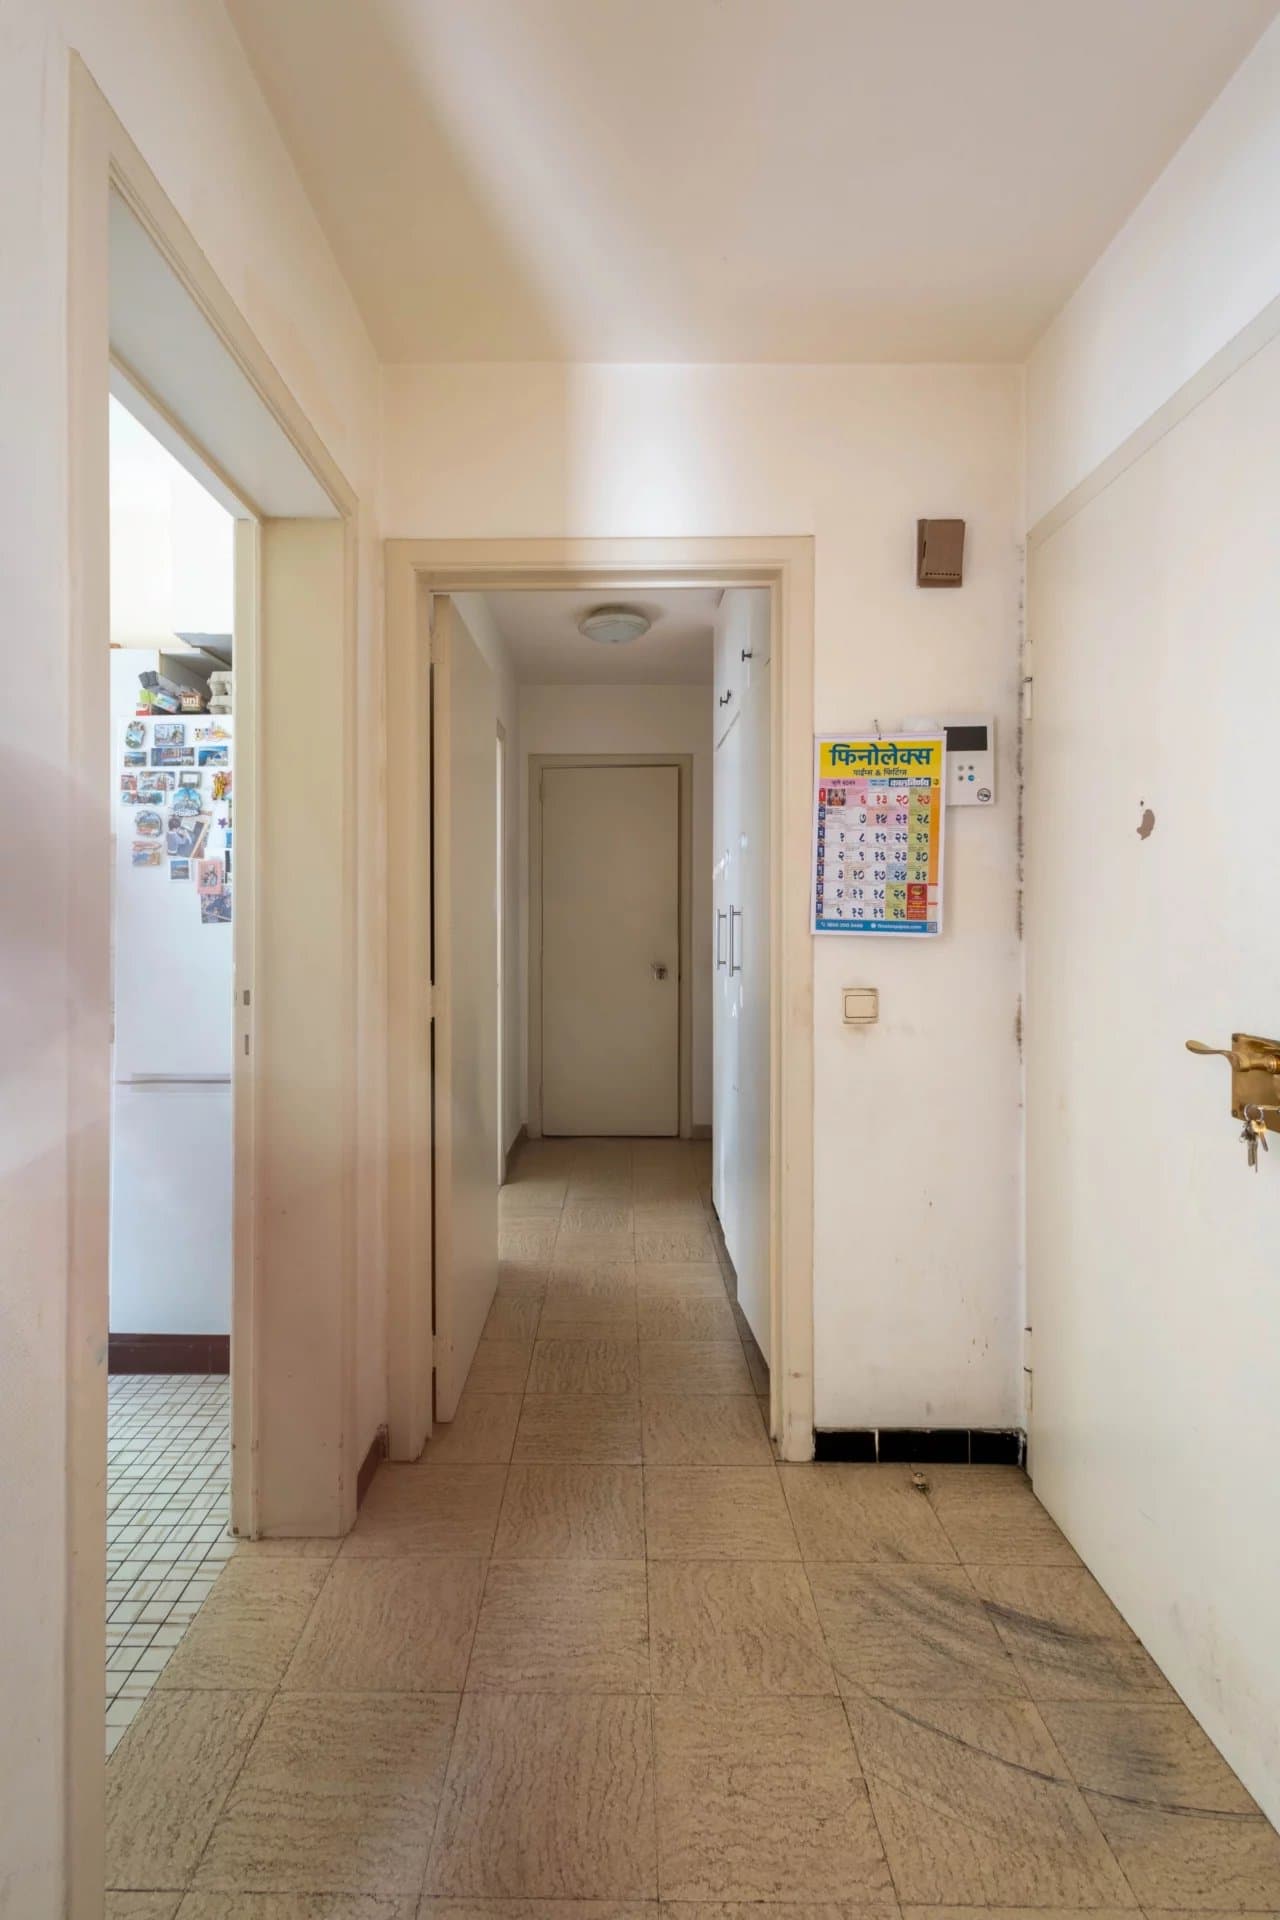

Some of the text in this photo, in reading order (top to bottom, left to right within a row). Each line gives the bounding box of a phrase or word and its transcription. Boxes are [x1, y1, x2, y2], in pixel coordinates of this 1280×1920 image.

[829, 743, 934, 766] फिनोलेक्स
[877, 795, 887, 804] १३
[896, 795, 908, 805] २०
[917, 795, 929, 805] २७
[876, 814, 887, 824] १४
[896, 814, 907, 824] २१
[917, 814, 929, 824] २८
[876, 833, 886, 842] १५
[896, 833, 907, 842] २२
[917, 833, 928, 842] २९
[875, 852, 885, 861] १६
[895, 852, 906, 861] २३
[916, 852, 928, 862] ३०
[853, 871, 864, 879] १०
[875, 871, 886, 880] १७
[895, 871, 907, 880] २४
[915, 872, 926, 881] ३१
[853, 889, 863, 899] ११
[874, 890, 885, 899] १८
[894, 890, 905, 899] २५
[852, 908, 863, 917] १२
[873, 908, 883, 918] १९
[893, 909, 905, 918] २६
